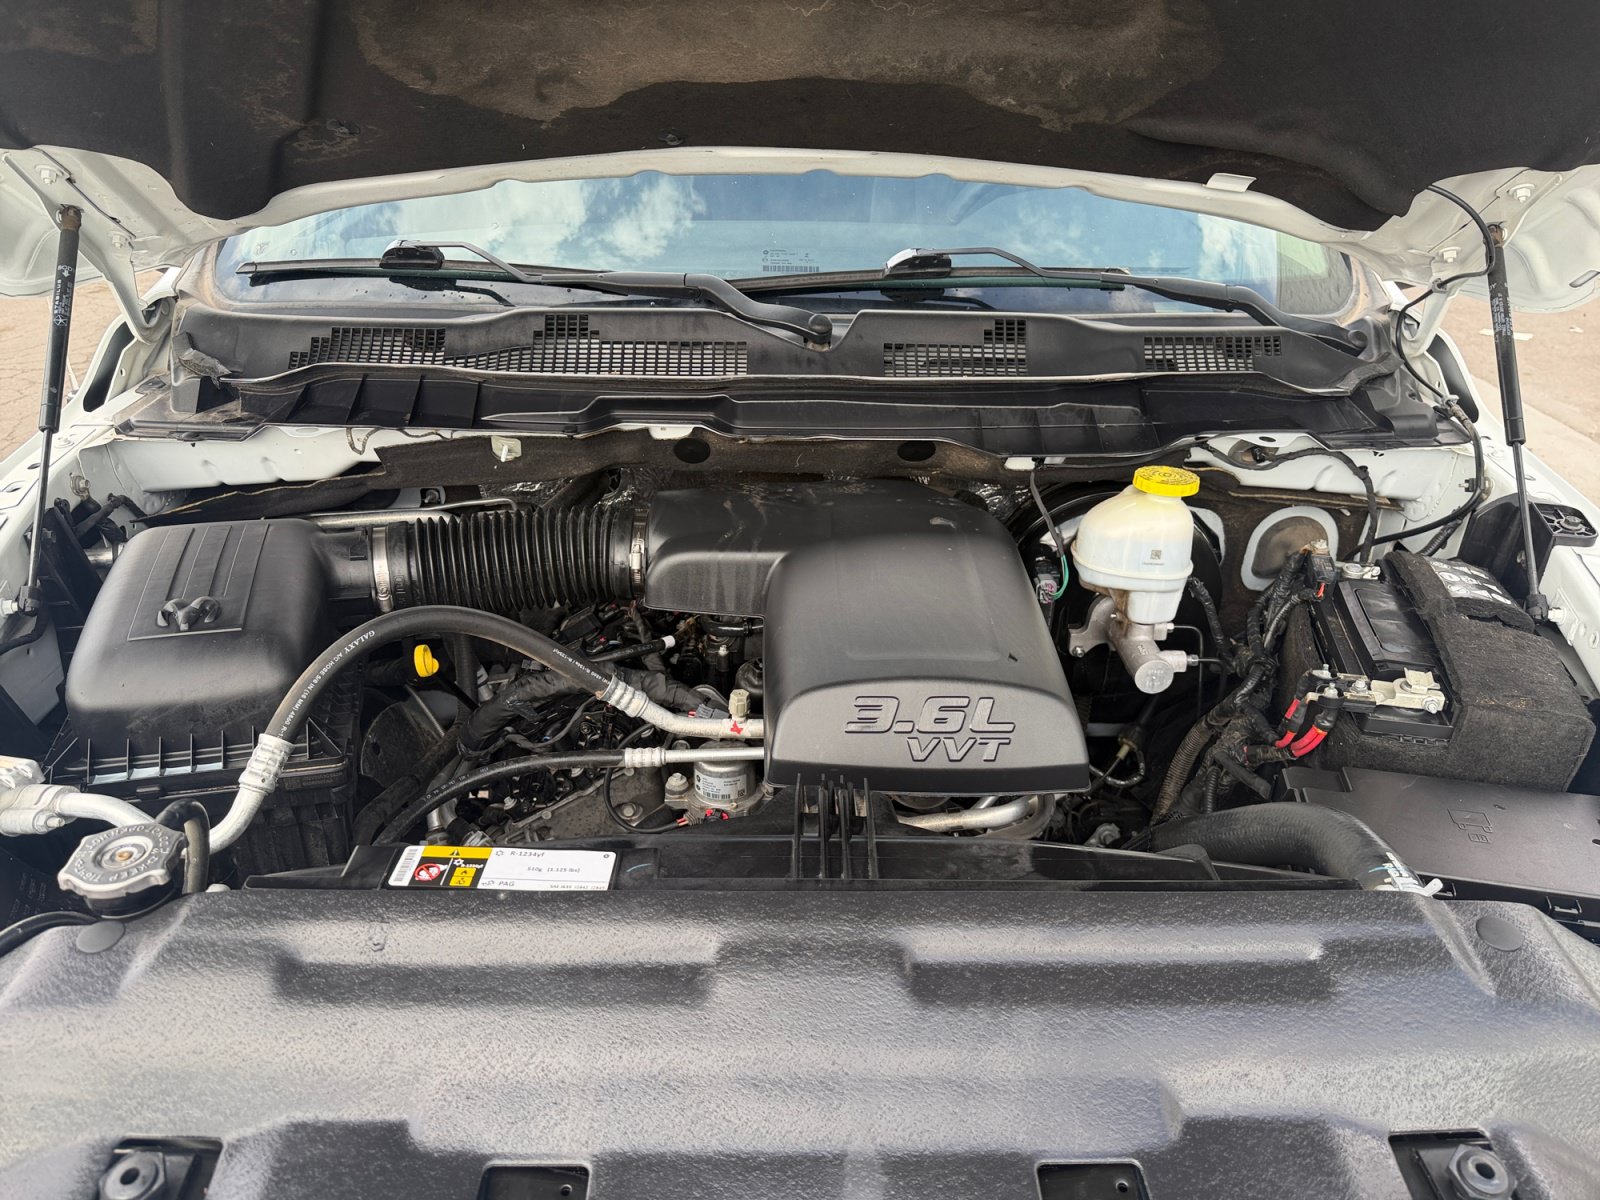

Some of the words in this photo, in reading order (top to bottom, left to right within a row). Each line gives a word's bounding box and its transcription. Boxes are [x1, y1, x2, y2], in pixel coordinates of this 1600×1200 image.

[344, 630, 375, 654] GALAXY
[333, 652, 343, 662] A/C
[319, 660, 335, 676] HOSE
[307, 683, 316, 691] IN
[844, 695, 1016, 734] 3.6L
[906, 736, 1012, 762] VVT
[510, 850, 545, 858] R-1234yf
